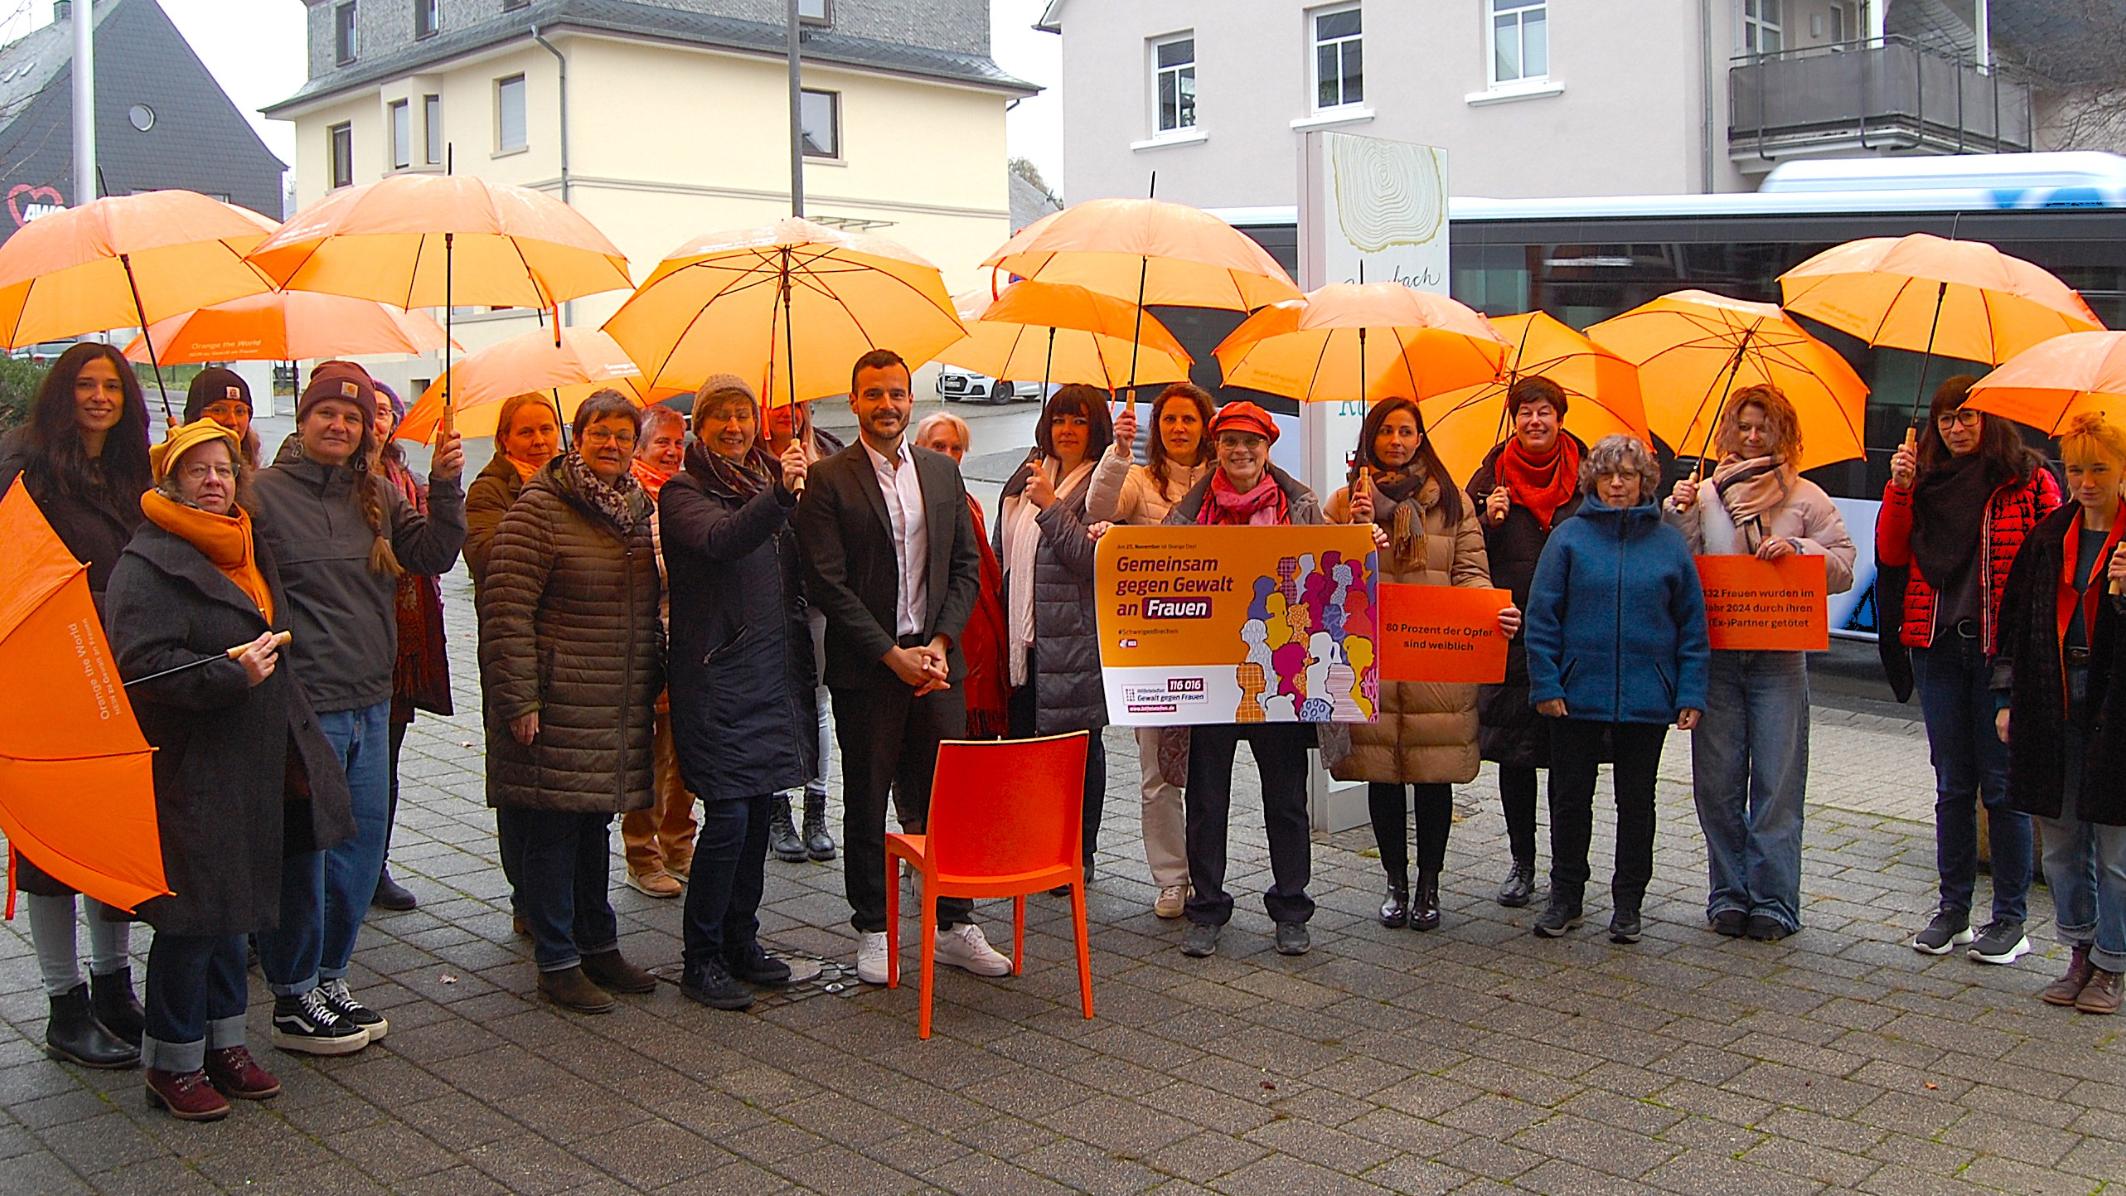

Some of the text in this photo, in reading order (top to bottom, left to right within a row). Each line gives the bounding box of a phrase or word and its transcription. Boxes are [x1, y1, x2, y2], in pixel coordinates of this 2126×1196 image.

[1116, 555, 1218, 572] Gemeinsam
[1115, 575, 1234, 596] gegen Gewalt
[1721, 589, 1757, 597] Frauen
[1759, 589, 1799, 598] wurden
[1801, 589, 1814, 597] im
[1116, 599, 1208, 617] an Frauen
[1726, 604, 1751, 612] 2024
[1753, 604, 1784, 613] durch
[1786, 604, 1813, 613] ihren
[1771, 618, 1809, 629] getötet
[1385, 623, 1494, 638] 80 Prozent der Opfer
[1403, 640, 1474, 651] sind weiblich
[67, 622, 110, 720] Orange the World
[1169, 680, 1201, 690] 116 016
[1137, 694, 1159, 702] Gewalt
[1181, 693, 1204, 701] Frauen
